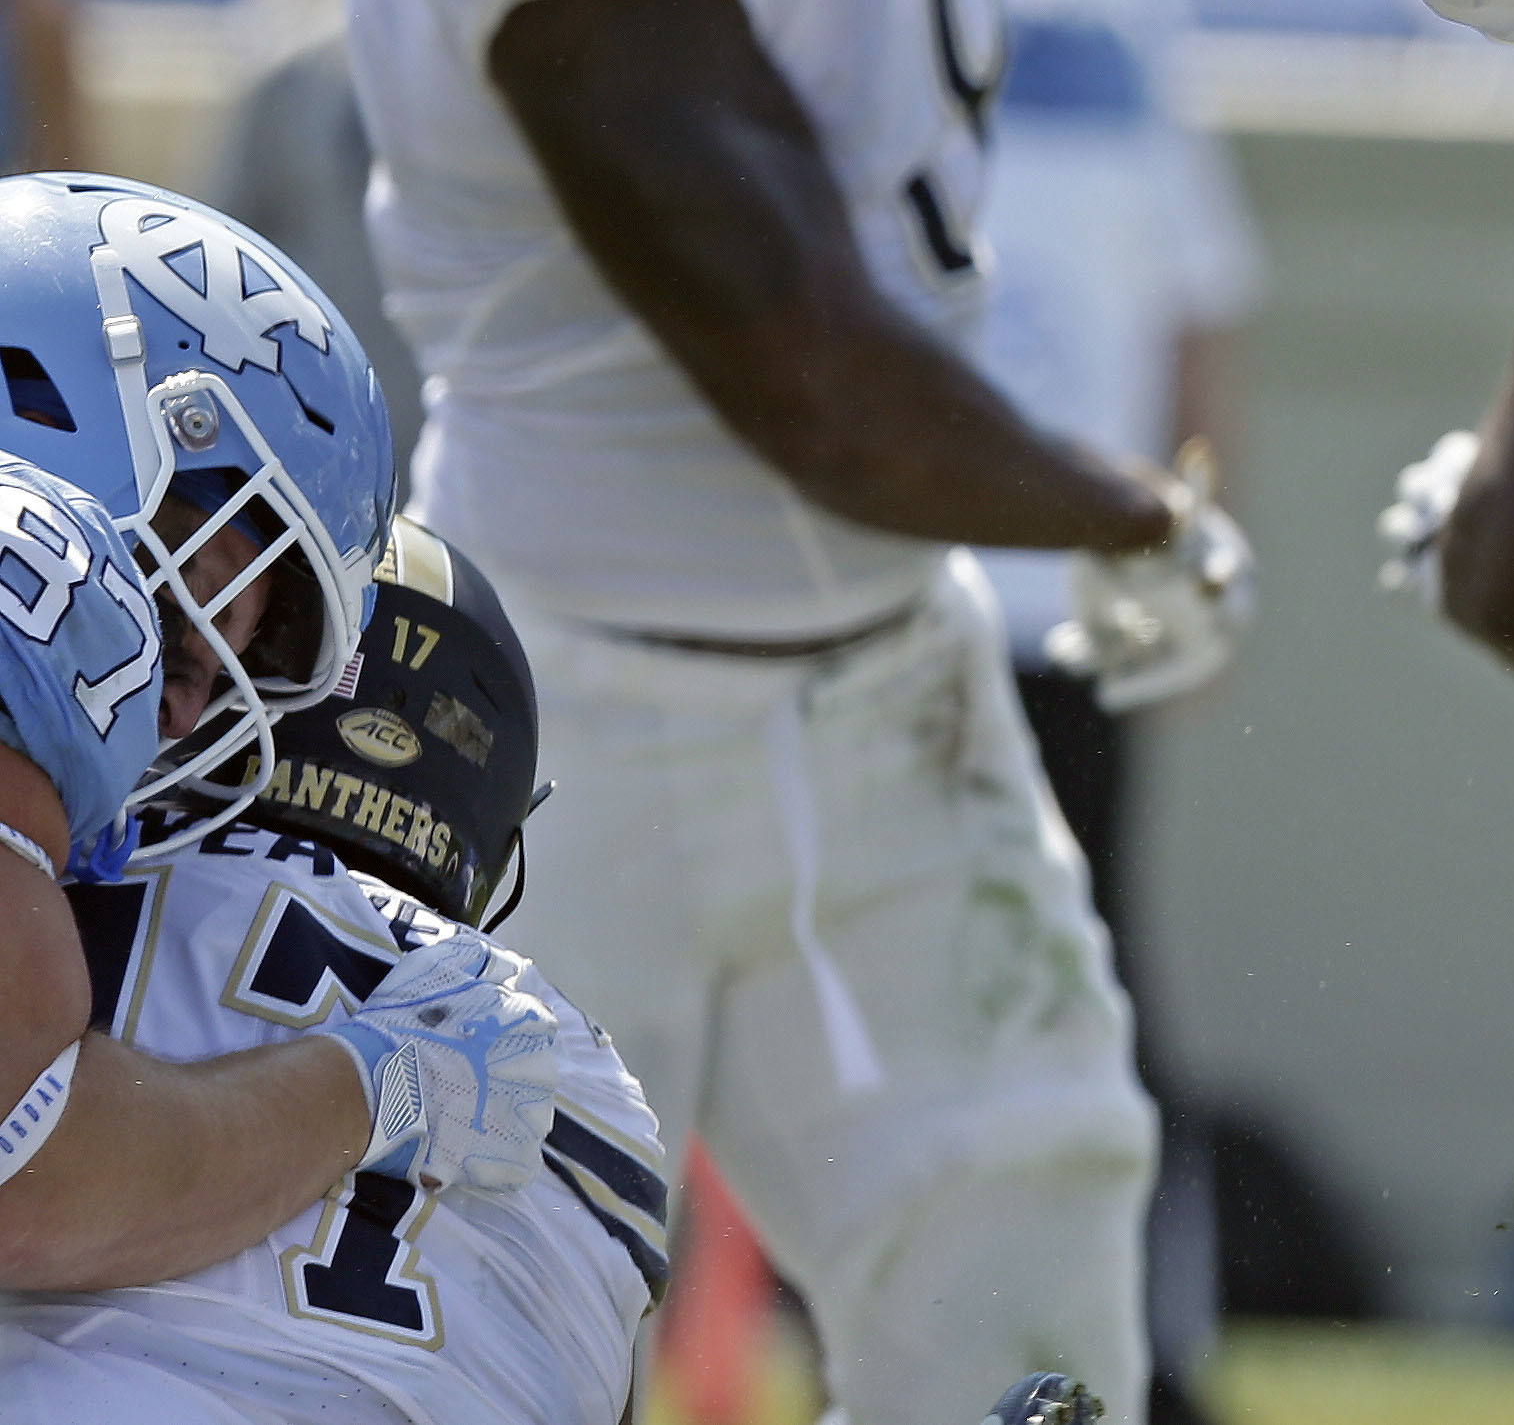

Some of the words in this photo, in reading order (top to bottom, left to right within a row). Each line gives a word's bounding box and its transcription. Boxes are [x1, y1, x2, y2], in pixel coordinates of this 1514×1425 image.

[0, 484, 161, 743] 87
[391, 615, 441, 671] 17
[350, 720, 410, 752] ACC
